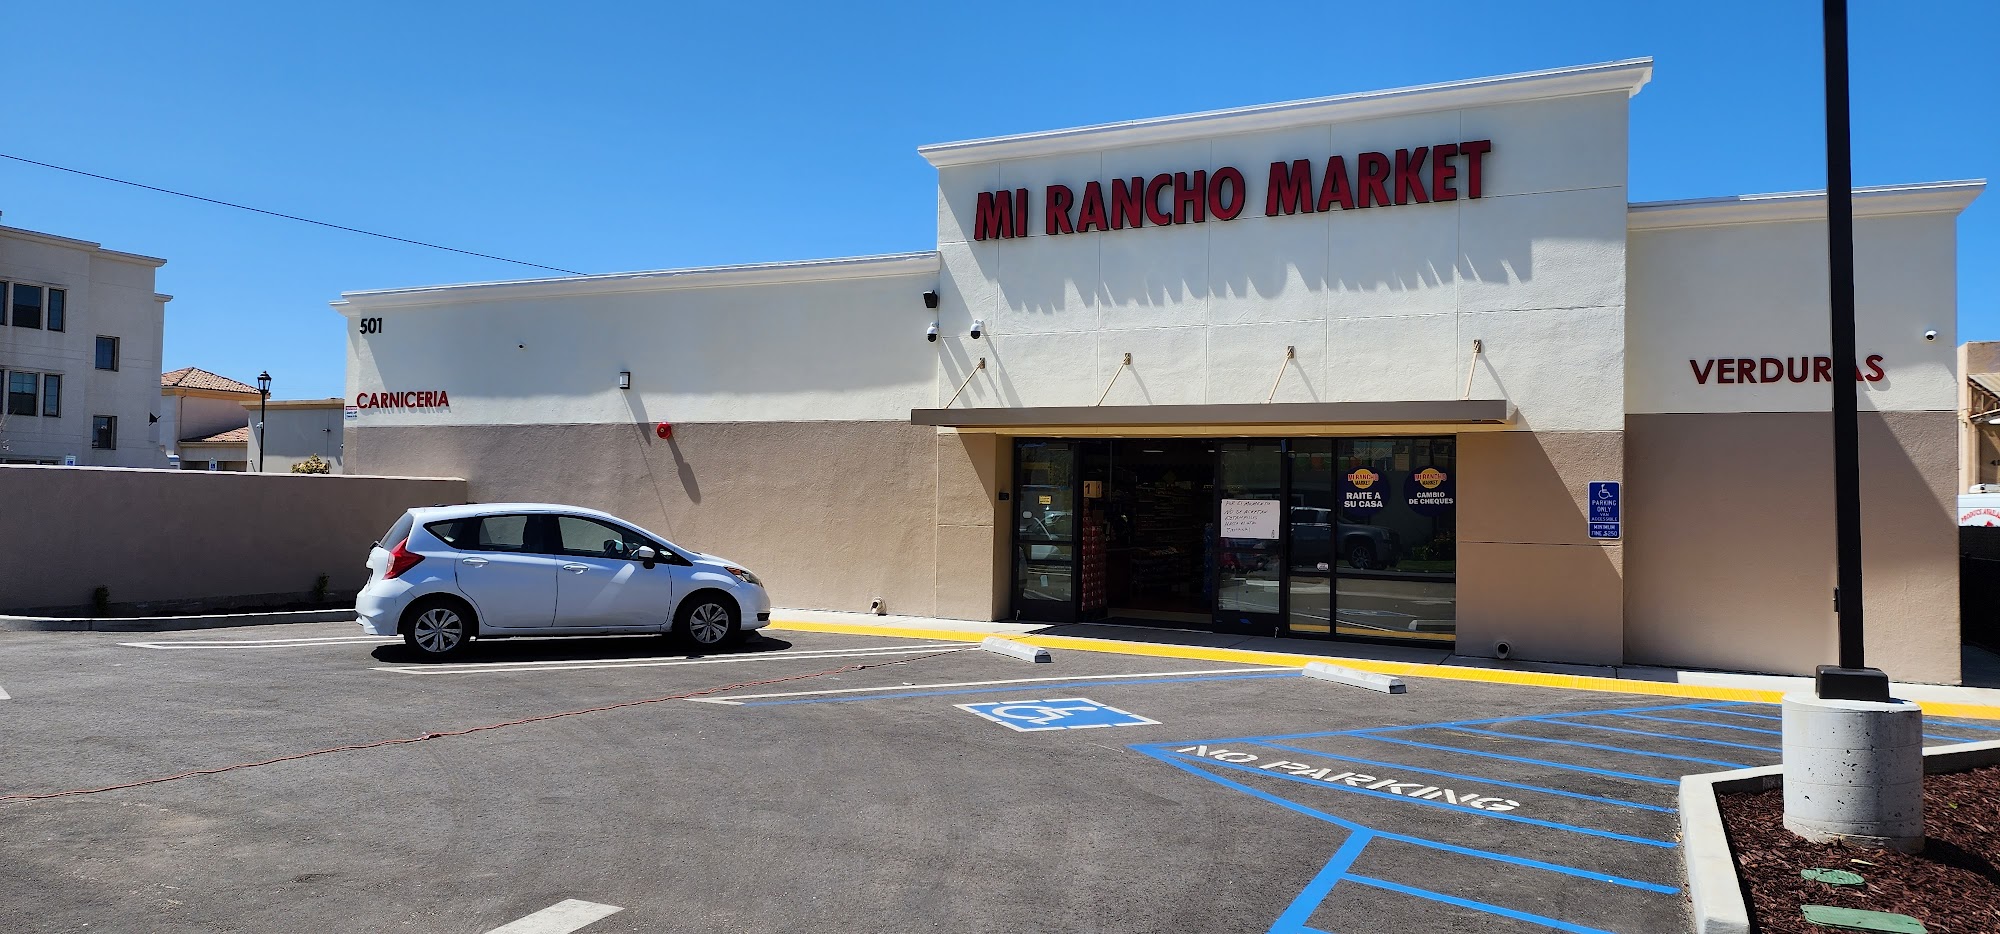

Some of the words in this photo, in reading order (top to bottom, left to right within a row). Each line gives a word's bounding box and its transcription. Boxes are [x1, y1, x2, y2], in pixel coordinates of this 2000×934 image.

[974, 188, 1028, 241] MI
[1046, 166, 1246, 235] RANCHO
[1265, 140, 1491, 217] MARKET
[360, 318, 382, 334] 501
[357, 391, 450, 408] CARNICERIA
[1085, 483, 1091, 495] 1
[1176, 745, 1258, 763] NO
[1259, 760, 1520, 811] PARKING
